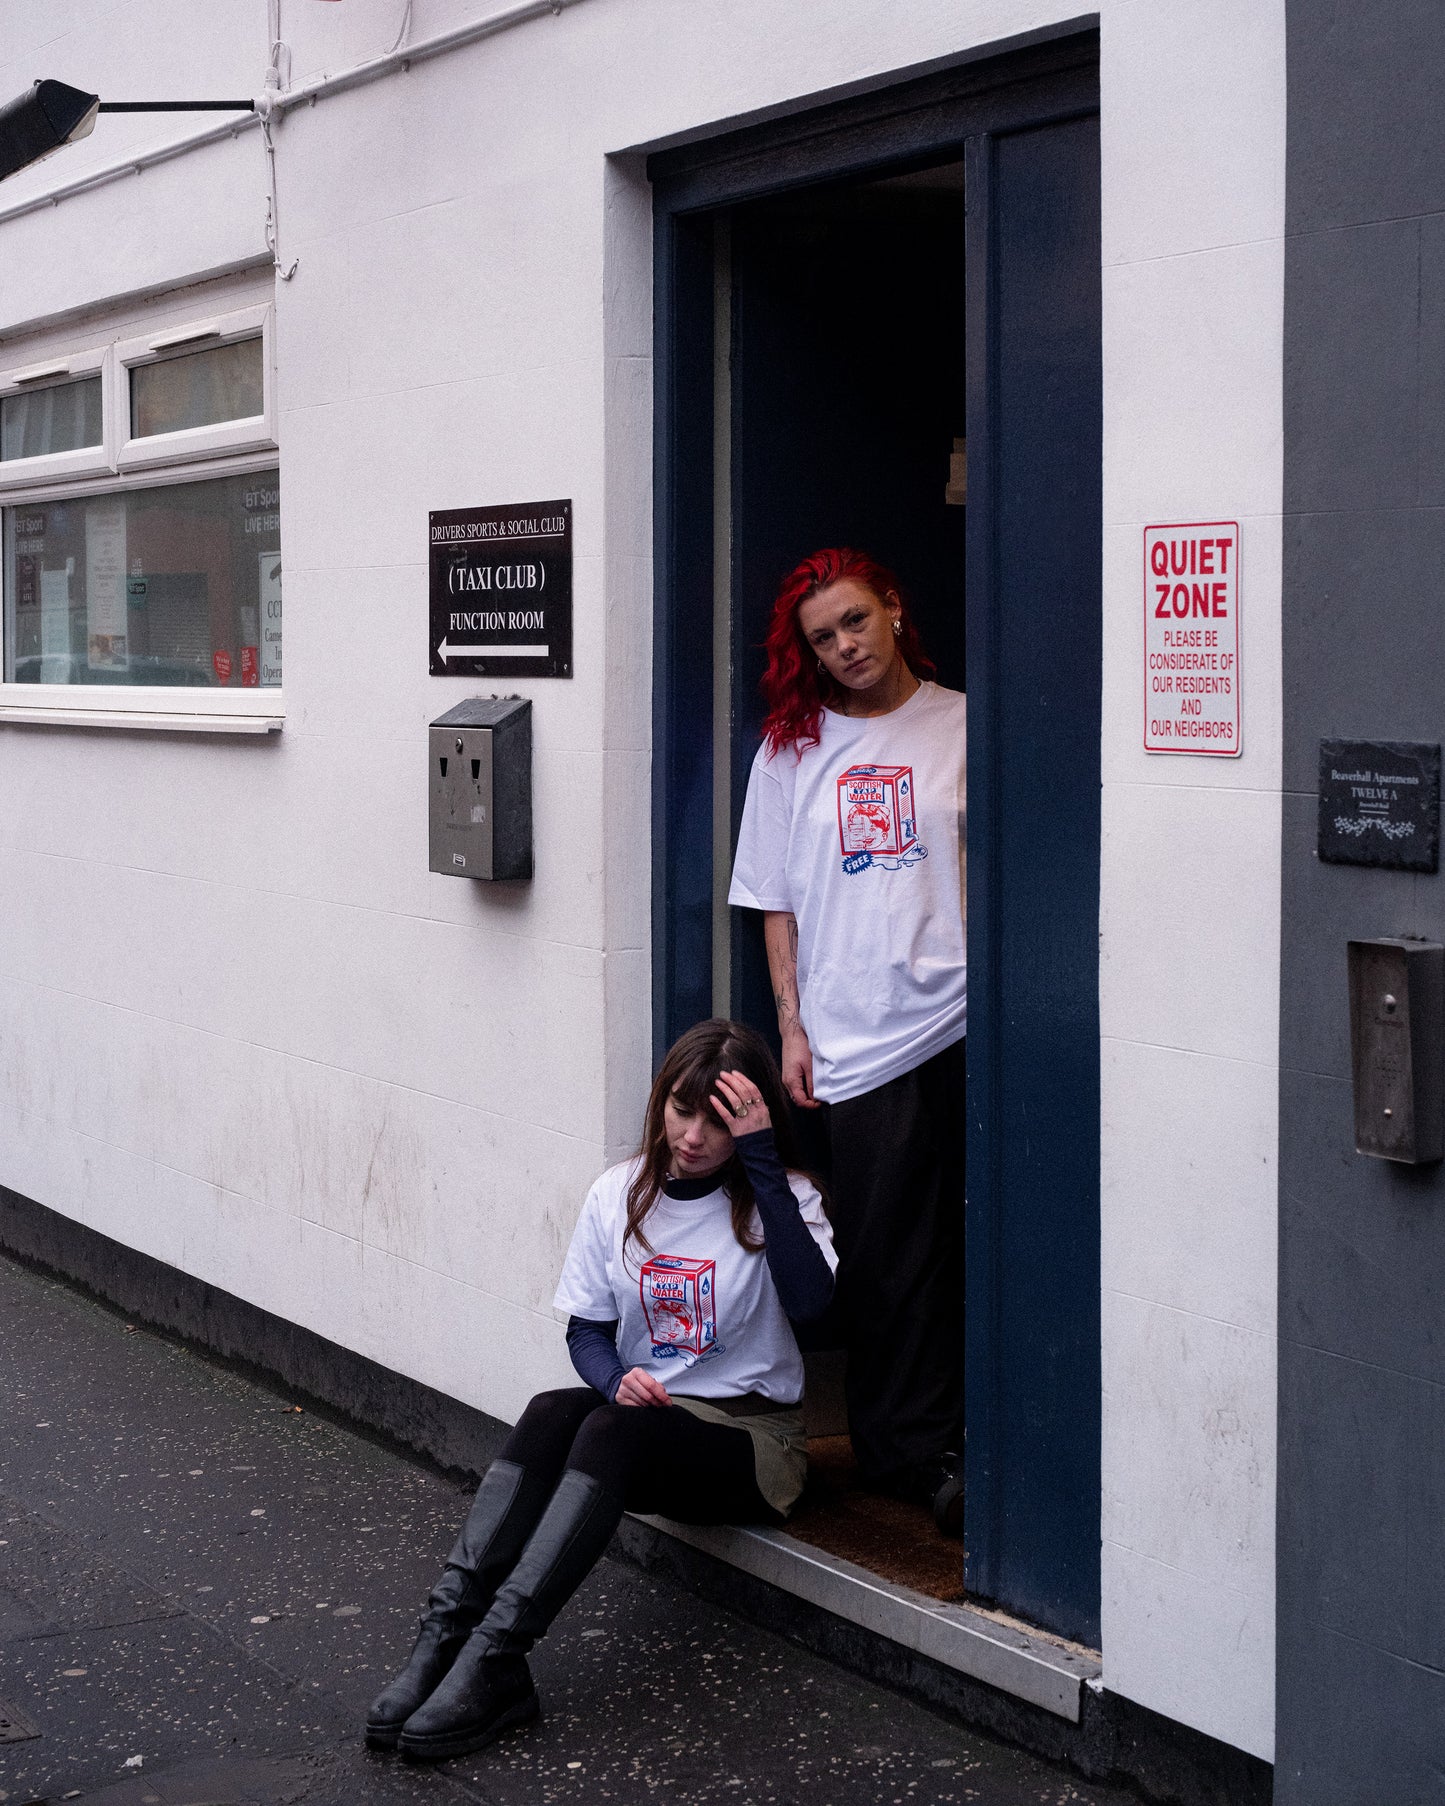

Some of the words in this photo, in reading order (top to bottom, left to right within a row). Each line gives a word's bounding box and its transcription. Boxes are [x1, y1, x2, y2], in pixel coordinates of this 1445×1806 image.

[246, 492, 260, 508] BT
[26, 517, 43, 534] Sport
[244, 516, 262, 534] LIVE
[432, 524, 466, 540] DRIVERS
[467, 522, 498, 538] SPORTS
[499, 521, 506, 536] &
[508, 519, 539, 535] SOCIAL
[541, 517, 565, 532] CLUB
[1151, 538, 1232, 578] QUIET
[1155, 583, 1228, 618] ZONE
[450, 612, 506, 630] FUNCTION
[508, 611, 544, 630] ROOM
[1164, 631, 1202, 647] PLEASE
[1205, 630, 1218, 646] BE
[1150, 654, 1217, 670] CONSIDERATE
[1220, 654, 1234, 670] OF
[1152, 676, 1173, 693] OUR
[1176, 676, 1231, 694] RESIDENTS
[1180, 699, 1202, 716] AND
[1151, 720, 1172, 737] OUR
[1175, 720, 1232, 738] NEIGHBORS
[1332, 769, 1372, 782] Beaverhall
[1373, 772, 1419, 786] Apartments
[1351, 787, 1388, 800] TWELVE
[1391, 790, 1398, 800] A
[846, 854, 870, 872] FREE
[652, 1274, 684, 1284] SCOTTISH
[652, 1287, 684, 1298] WATER
[654, 1346, 676, 1357] FREE
